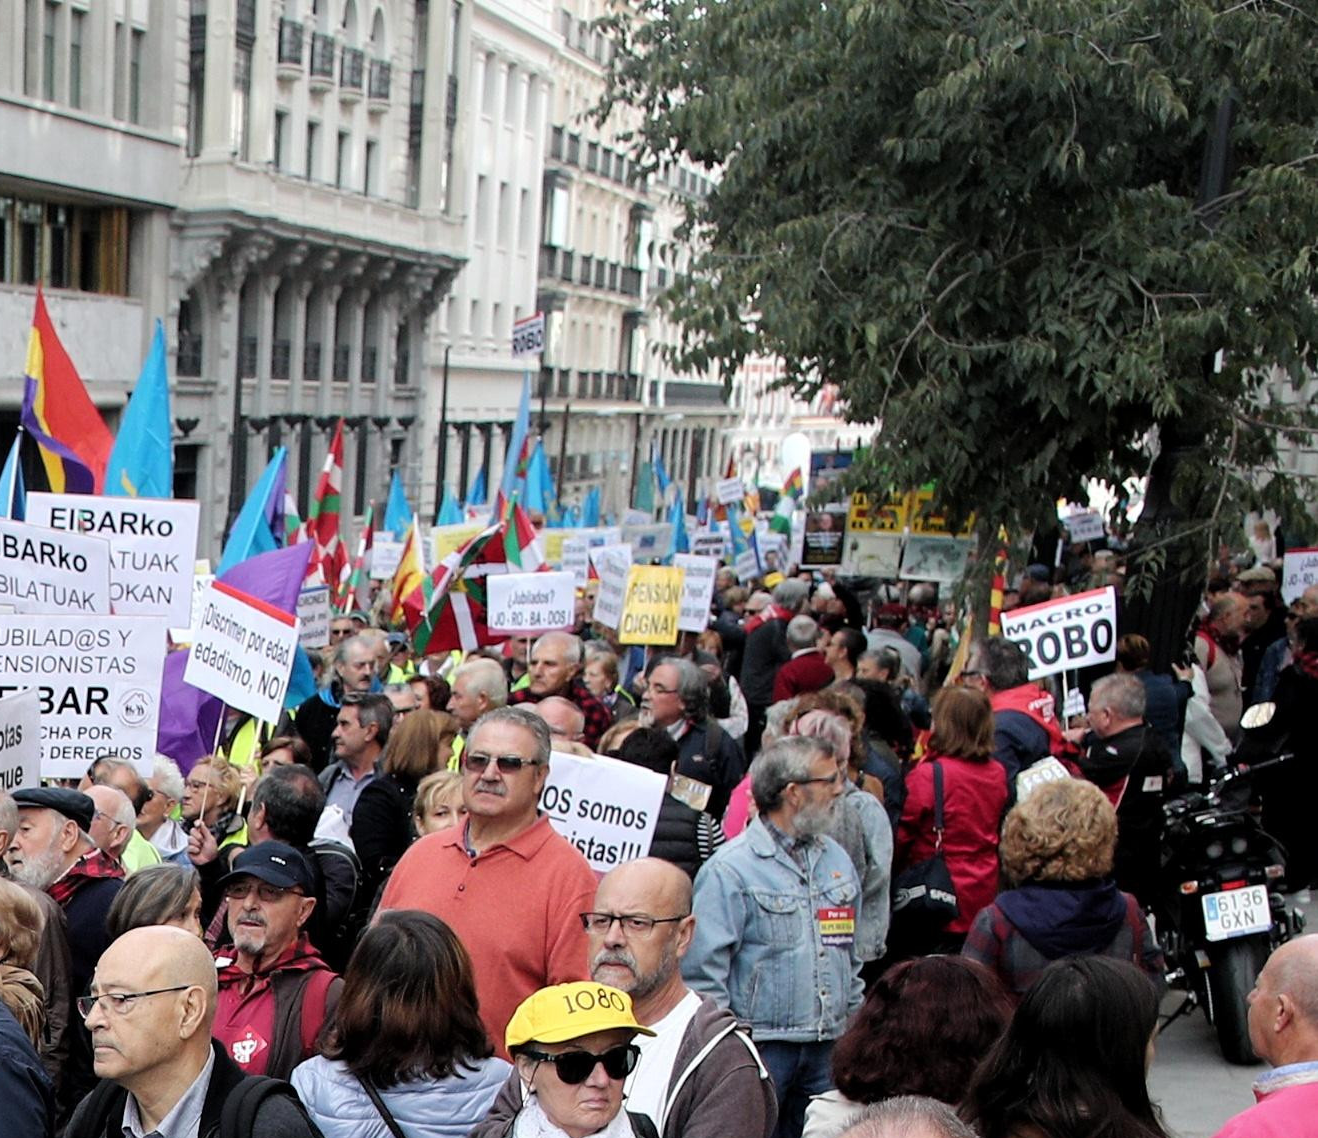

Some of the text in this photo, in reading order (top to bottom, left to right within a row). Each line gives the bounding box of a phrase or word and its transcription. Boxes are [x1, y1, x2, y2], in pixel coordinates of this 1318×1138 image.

[50, 508, 174, 537] EIBARko
[1006, 604, 1113, 637] MACRO-
[118, 629, 133, 647] Y
[258, 674, 286, 705] NO!
[78, 726, 113, 740] POR
[50, 745, 143, 761] DERECHOS
[577, 794, 648, 831] somos
[1217, 888, 1264, 912] 6136
[1220, 910, 1256, 931] GXN
[563, 990, 625, 1015] 1080
